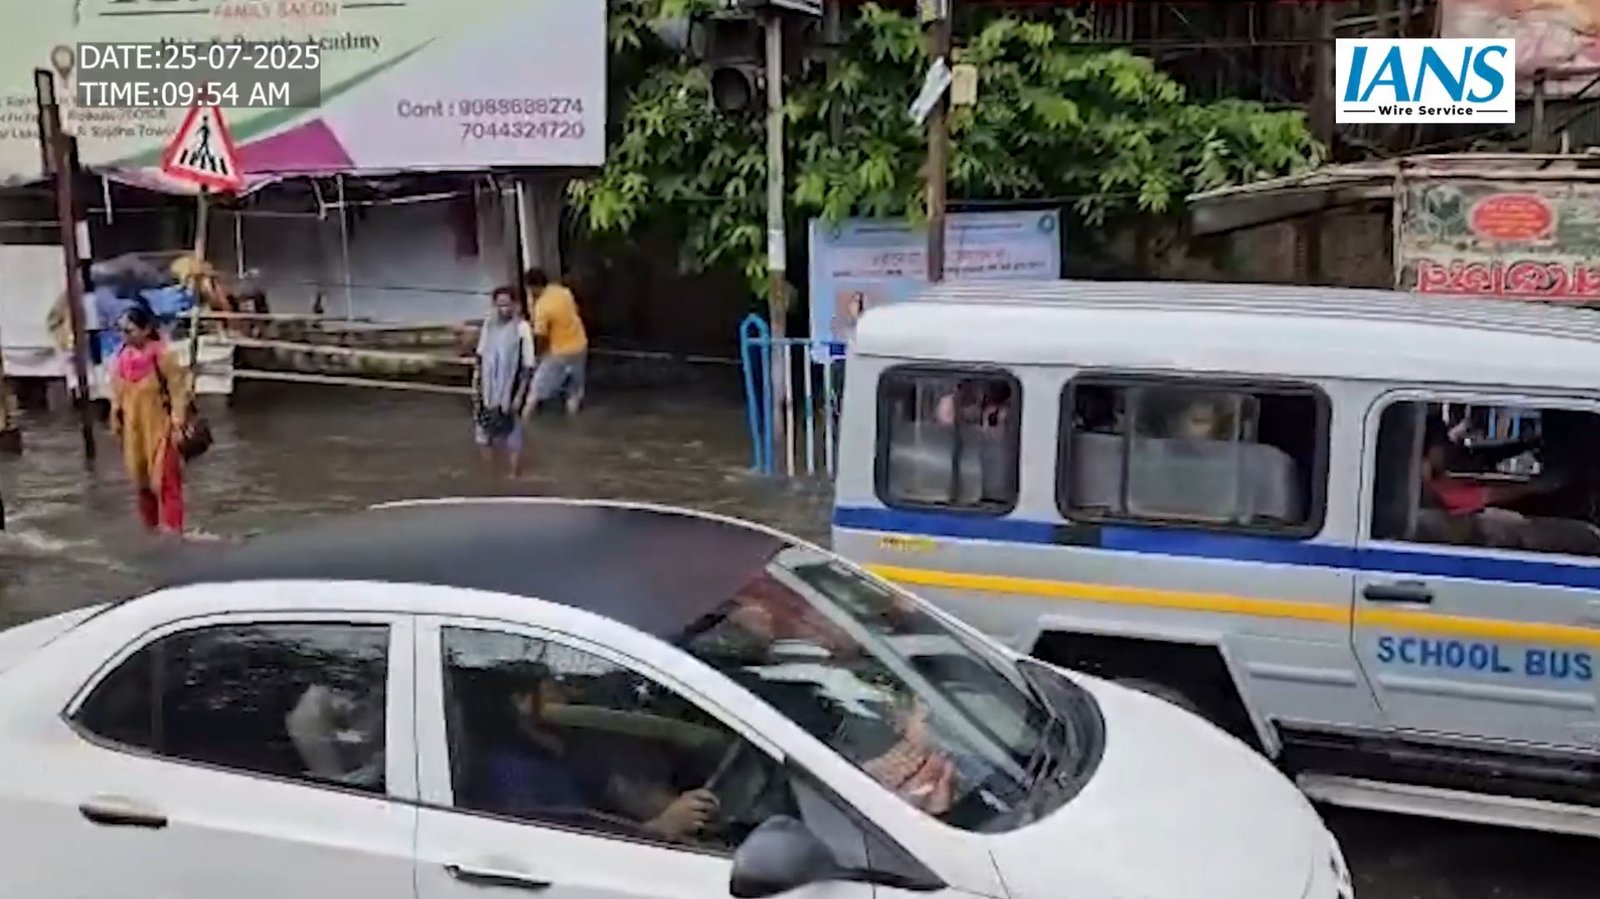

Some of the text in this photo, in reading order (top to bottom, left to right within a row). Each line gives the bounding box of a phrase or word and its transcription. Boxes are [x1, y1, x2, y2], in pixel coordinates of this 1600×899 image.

[279, 1, 338, 18] SALON
[1377, 635, 1594, 681] SCHOOL BUS
